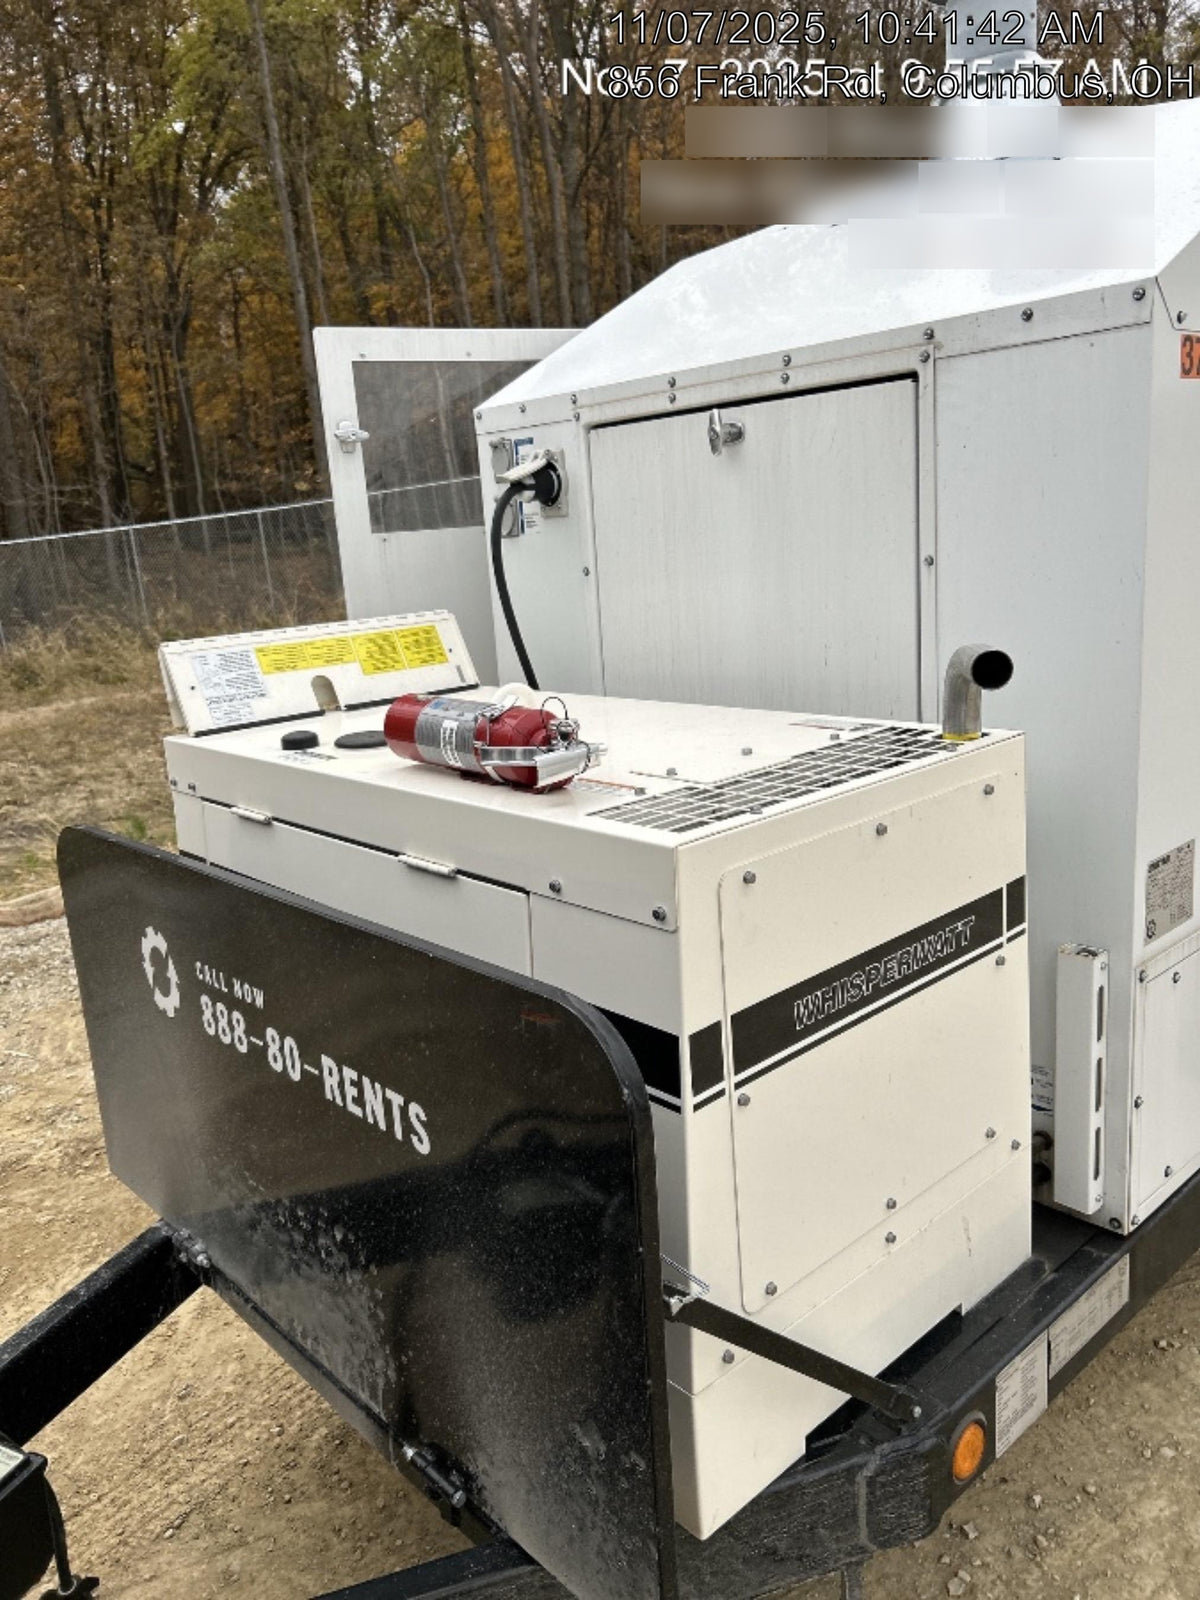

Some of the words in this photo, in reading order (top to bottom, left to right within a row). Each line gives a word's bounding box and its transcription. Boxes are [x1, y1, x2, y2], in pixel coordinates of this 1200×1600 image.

[195, 961, 228, 993] CALL
[232, 977, 264, 1010] NOW
[794, 915, 975, 1031] WHISPERWATT
[200, 994, 431, 1156] 888-80-RENTS
